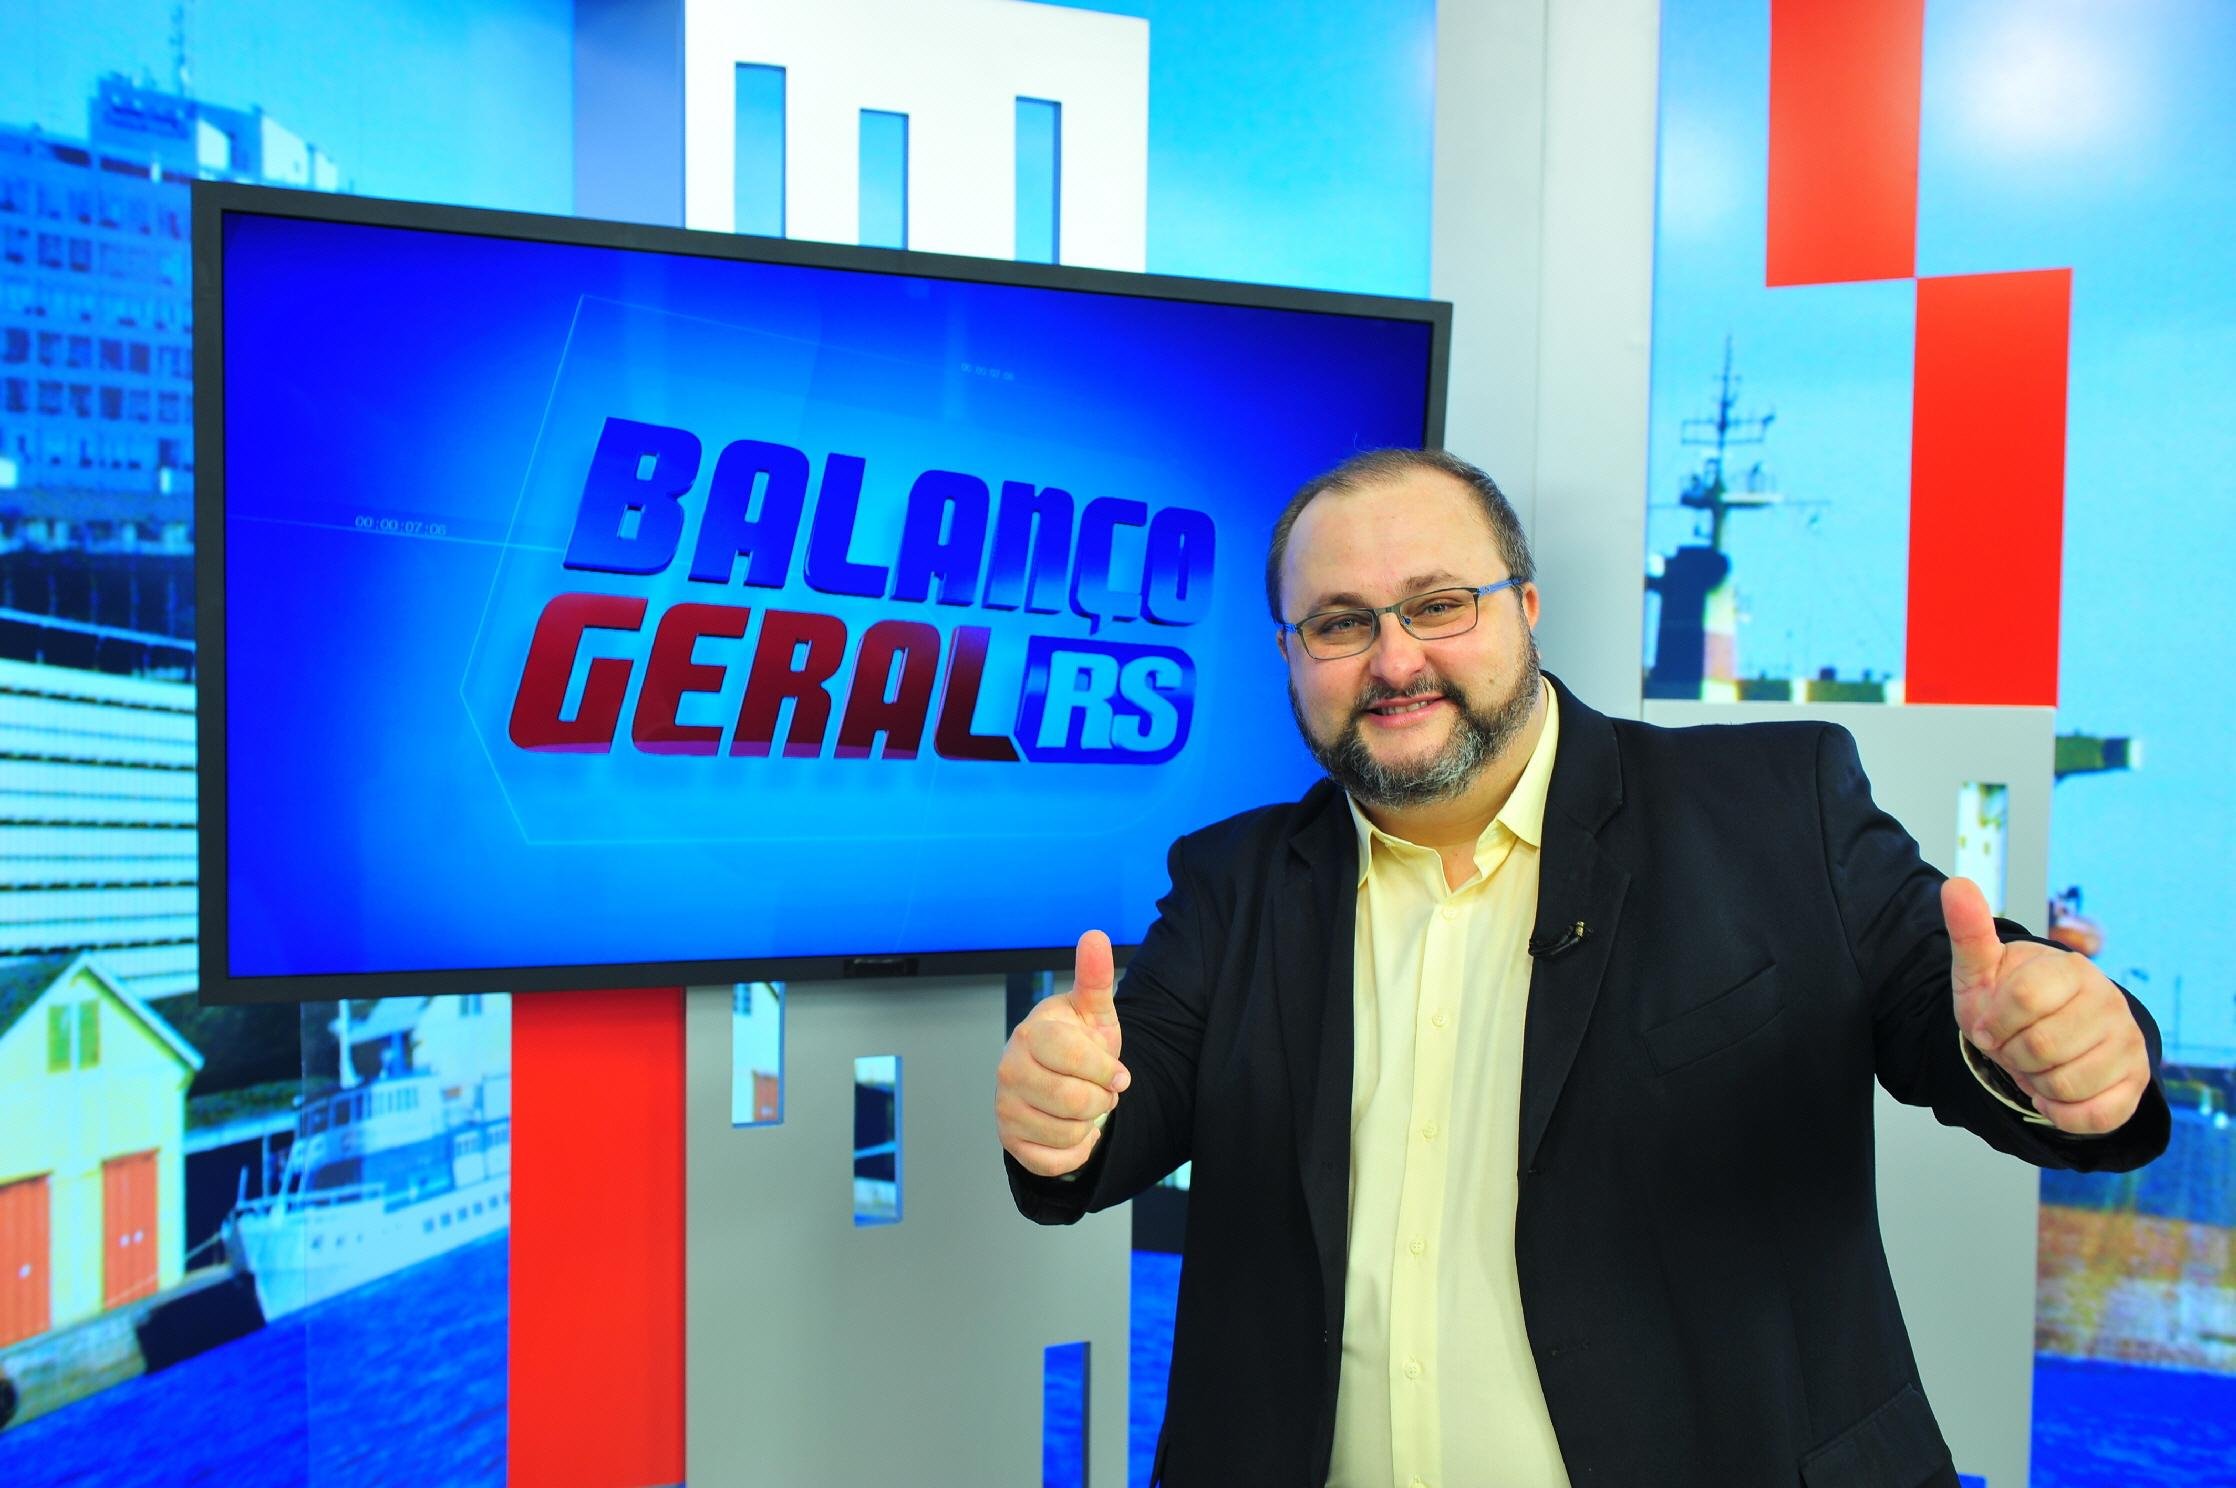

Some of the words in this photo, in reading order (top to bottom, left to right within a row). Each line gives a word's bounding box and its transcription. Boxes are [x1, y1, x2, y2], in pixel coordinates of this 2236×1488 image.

[562, 416, 1217, 636] BALANÇO
[508, 592, 1021, 763] GERAL
[1036, 650, 1183, 753] RS
